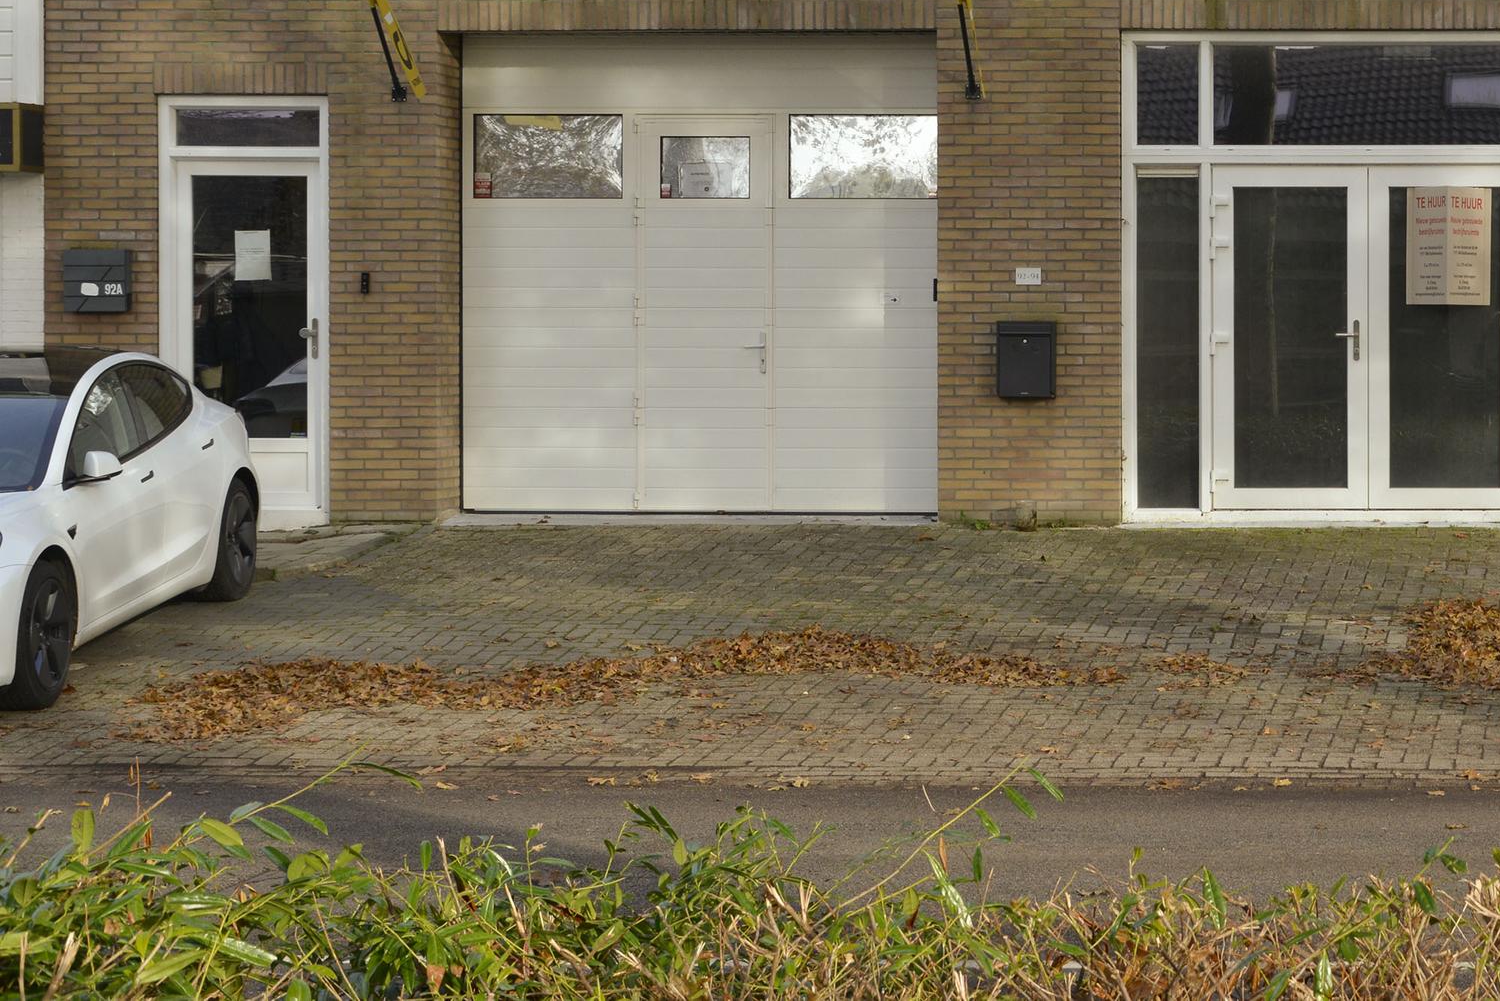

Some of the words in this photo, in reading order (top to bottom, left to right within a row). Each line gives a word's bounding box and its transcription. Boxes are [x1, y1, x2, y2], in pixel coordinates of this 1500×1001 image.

[1416, 197, 1426, 209] TE
[1427, 196, 1446, 209] HUUR
[1451, 196, 1460, 209] TE
[1461, 198, 1483, 210] HUUR
[104, 283, 123, 295] 92A
